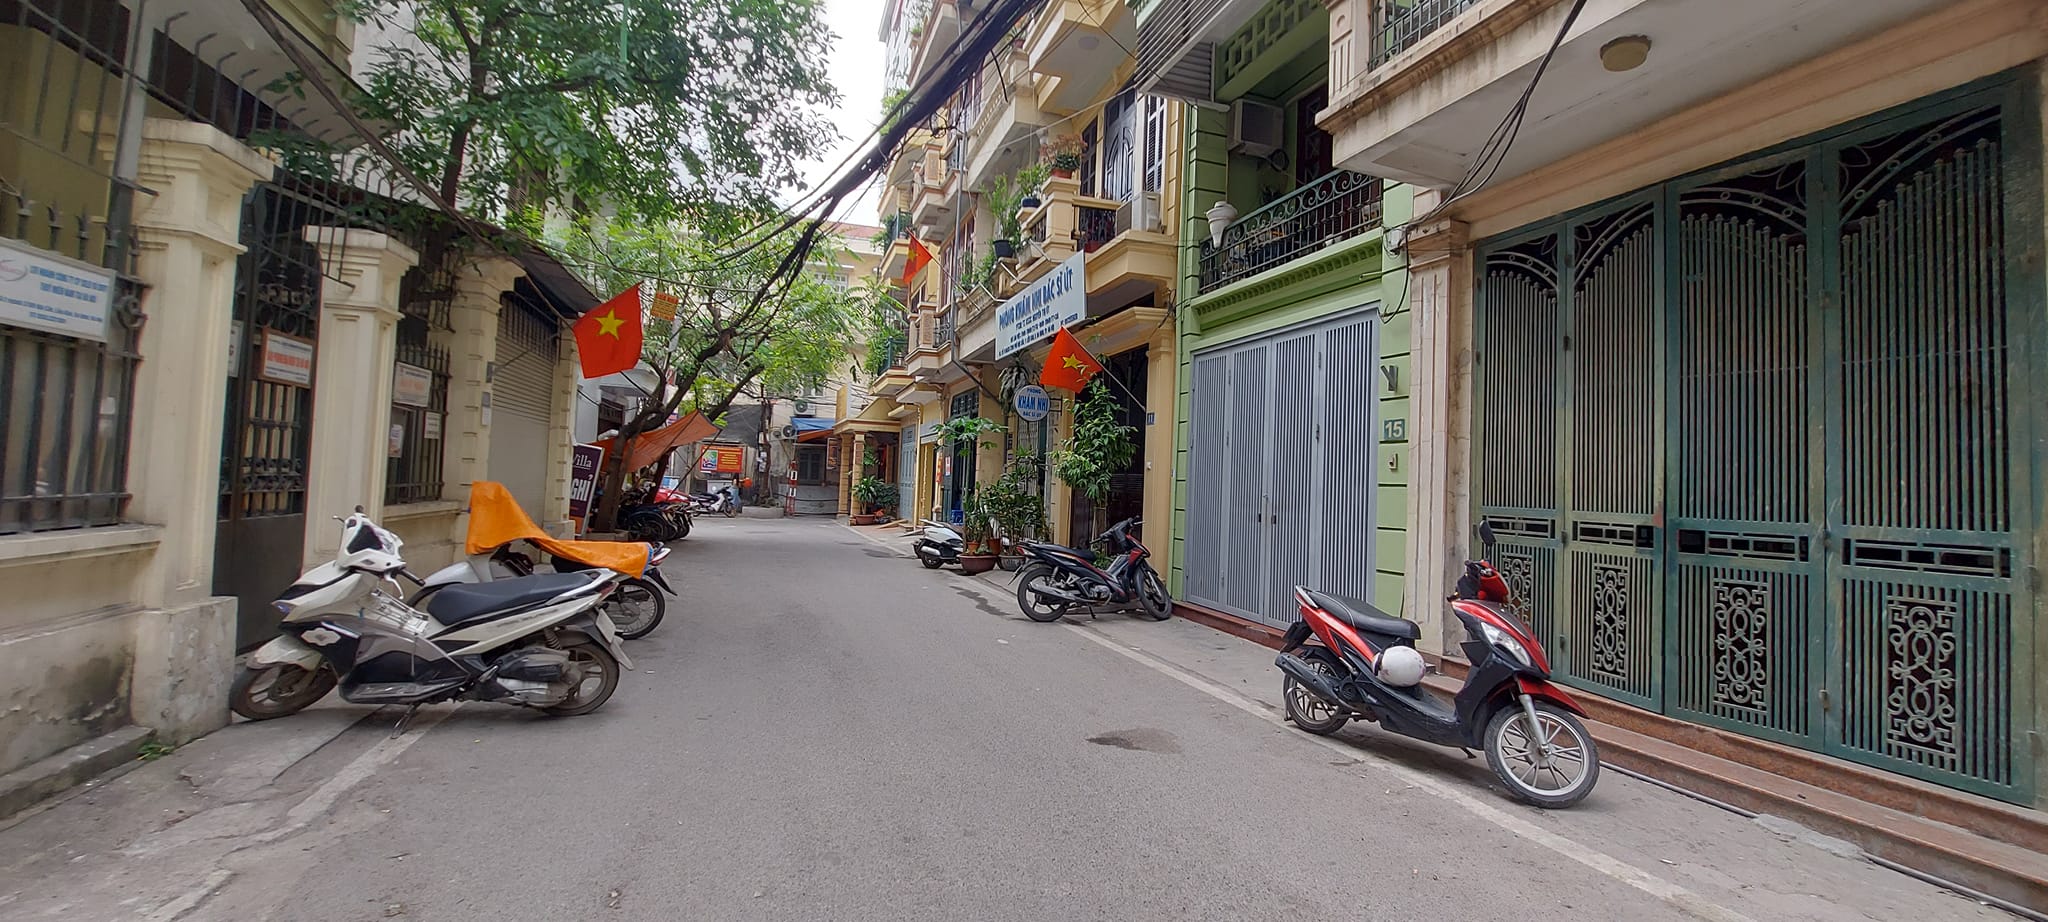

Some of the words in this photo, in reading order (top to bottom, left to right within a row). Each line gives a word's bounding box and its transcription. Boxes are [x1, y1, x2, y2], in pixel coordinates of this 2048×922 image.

[999, 305, 1015, 331] PHÒNG
[1015, 295, 1031, 318] KHÁM
[1031, 287, 1042, 309] NHI
[1043, 278, 1055, 304] BÁC
[1018, 394, 1036, 409] KHÁM
[1037, 397, 1049, 412] NHI
[1385, 421, 1402, 438] 15
